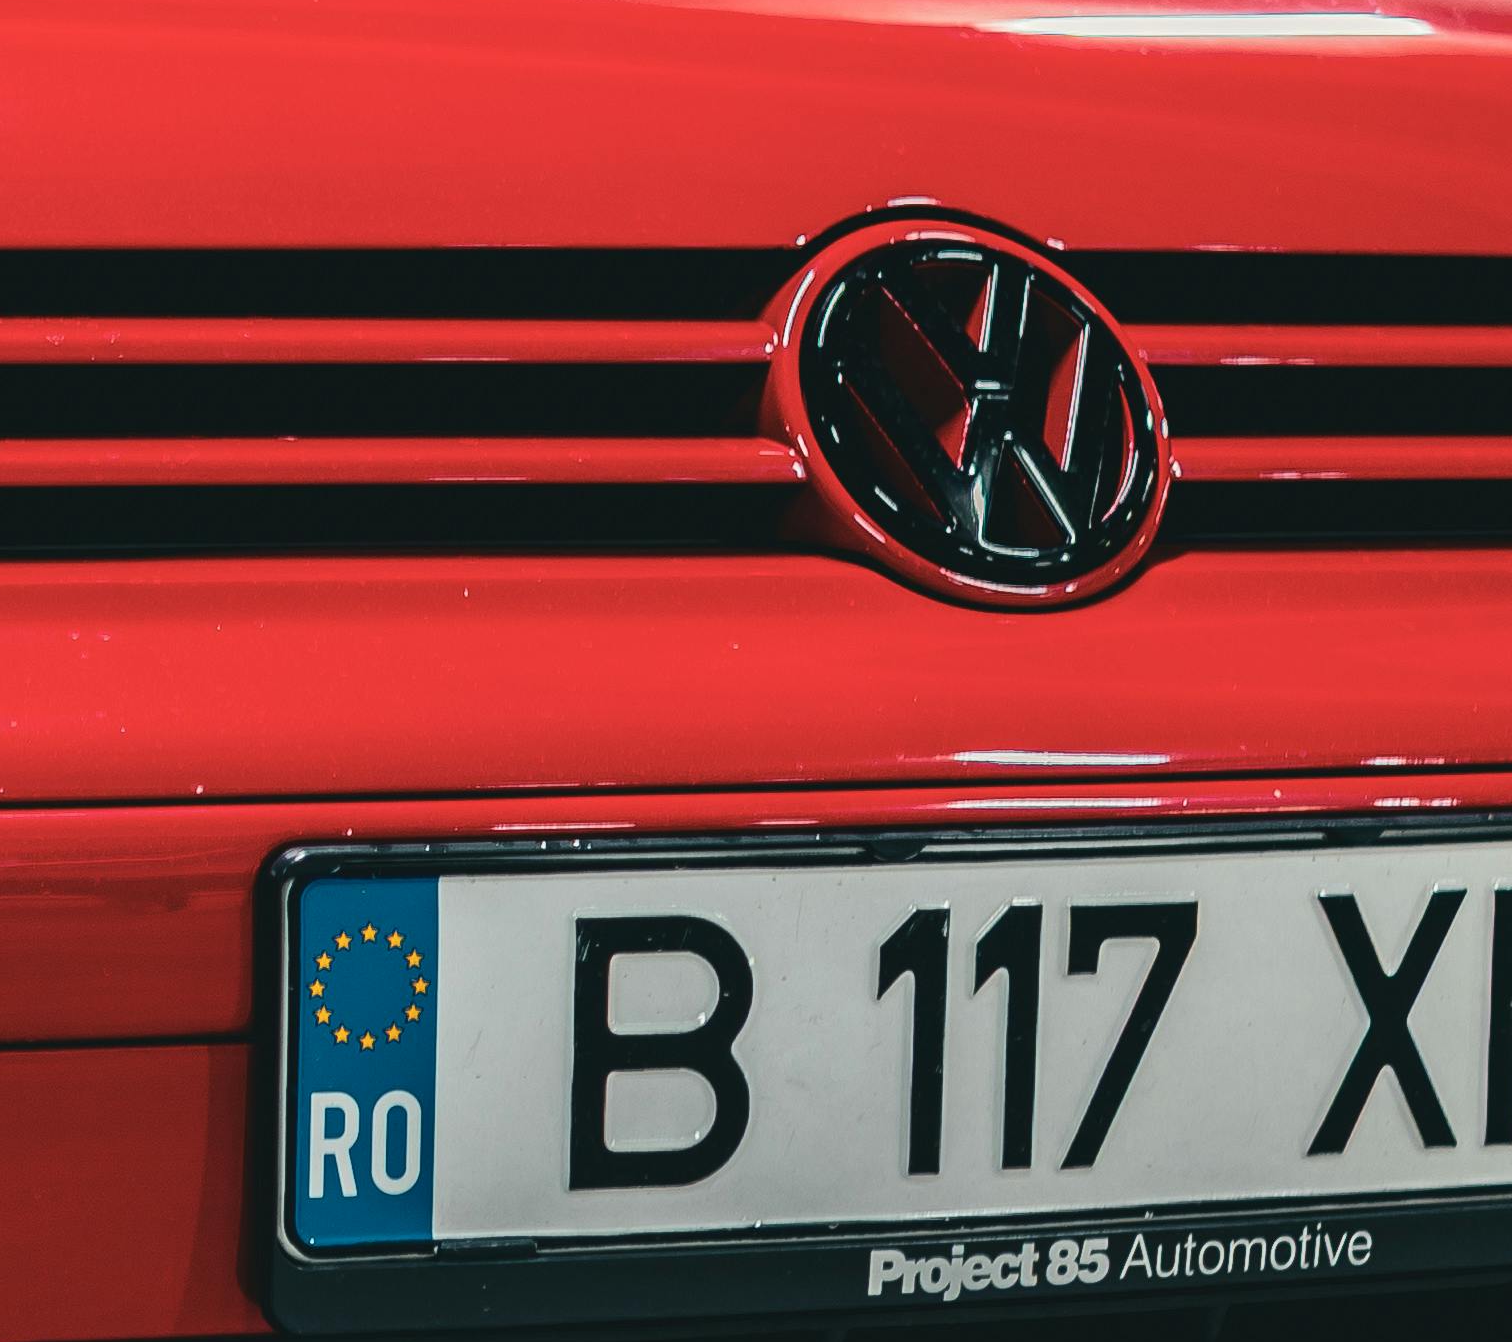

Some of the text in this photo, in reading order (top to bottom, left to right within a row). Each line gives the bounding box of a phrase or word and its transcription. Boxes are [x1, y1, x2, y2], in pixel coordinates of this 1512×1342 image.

[568, 914, 755, 1192] B
[875, 899, 1200, 1177] 117
[308, 1089, 422, 1199] RO
[867, 1221, 1374, 1302] Project 85 Automotive
